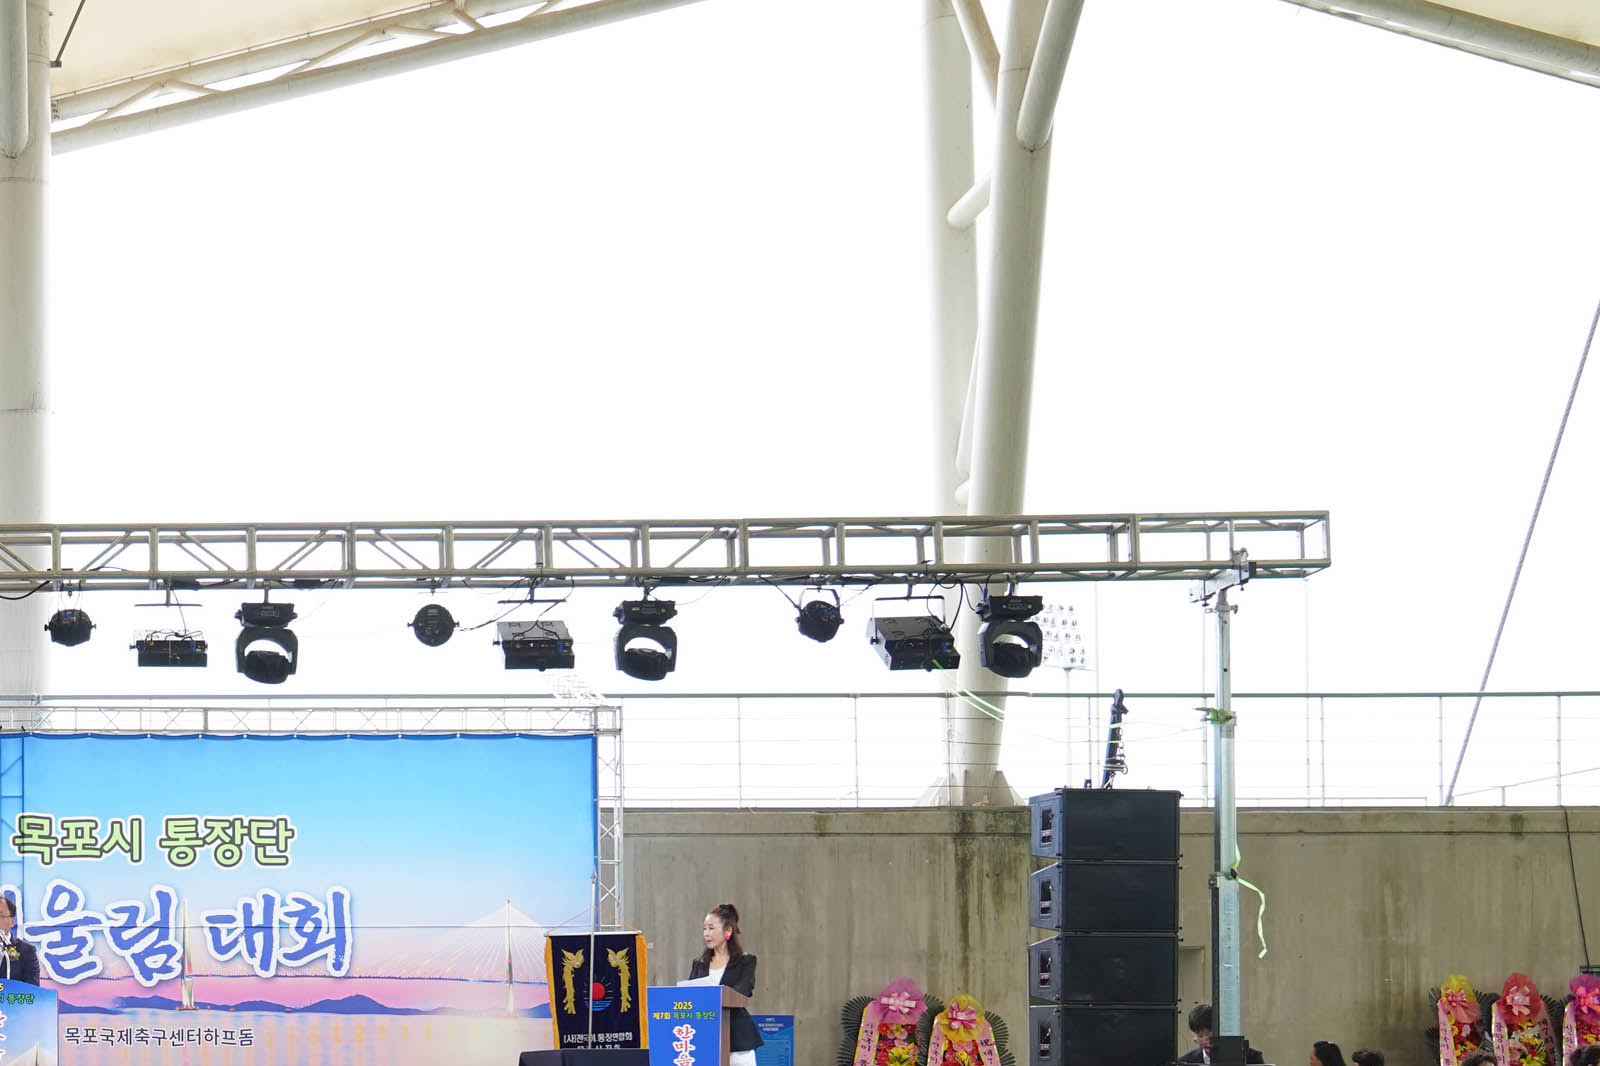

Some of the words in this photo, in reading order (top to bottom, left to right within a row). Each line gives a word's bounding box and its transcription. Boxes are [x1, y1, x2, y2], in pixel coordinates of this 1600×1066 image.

[12, 813, 143, 866] 목포시
[160, 815, 296, 867] 통장단
[202, 886, 352, 977] 대회
[673, 1001, 693, 1010] 2025
[64, 1027, 255, 1048] 목포국제축구센터하프돔
